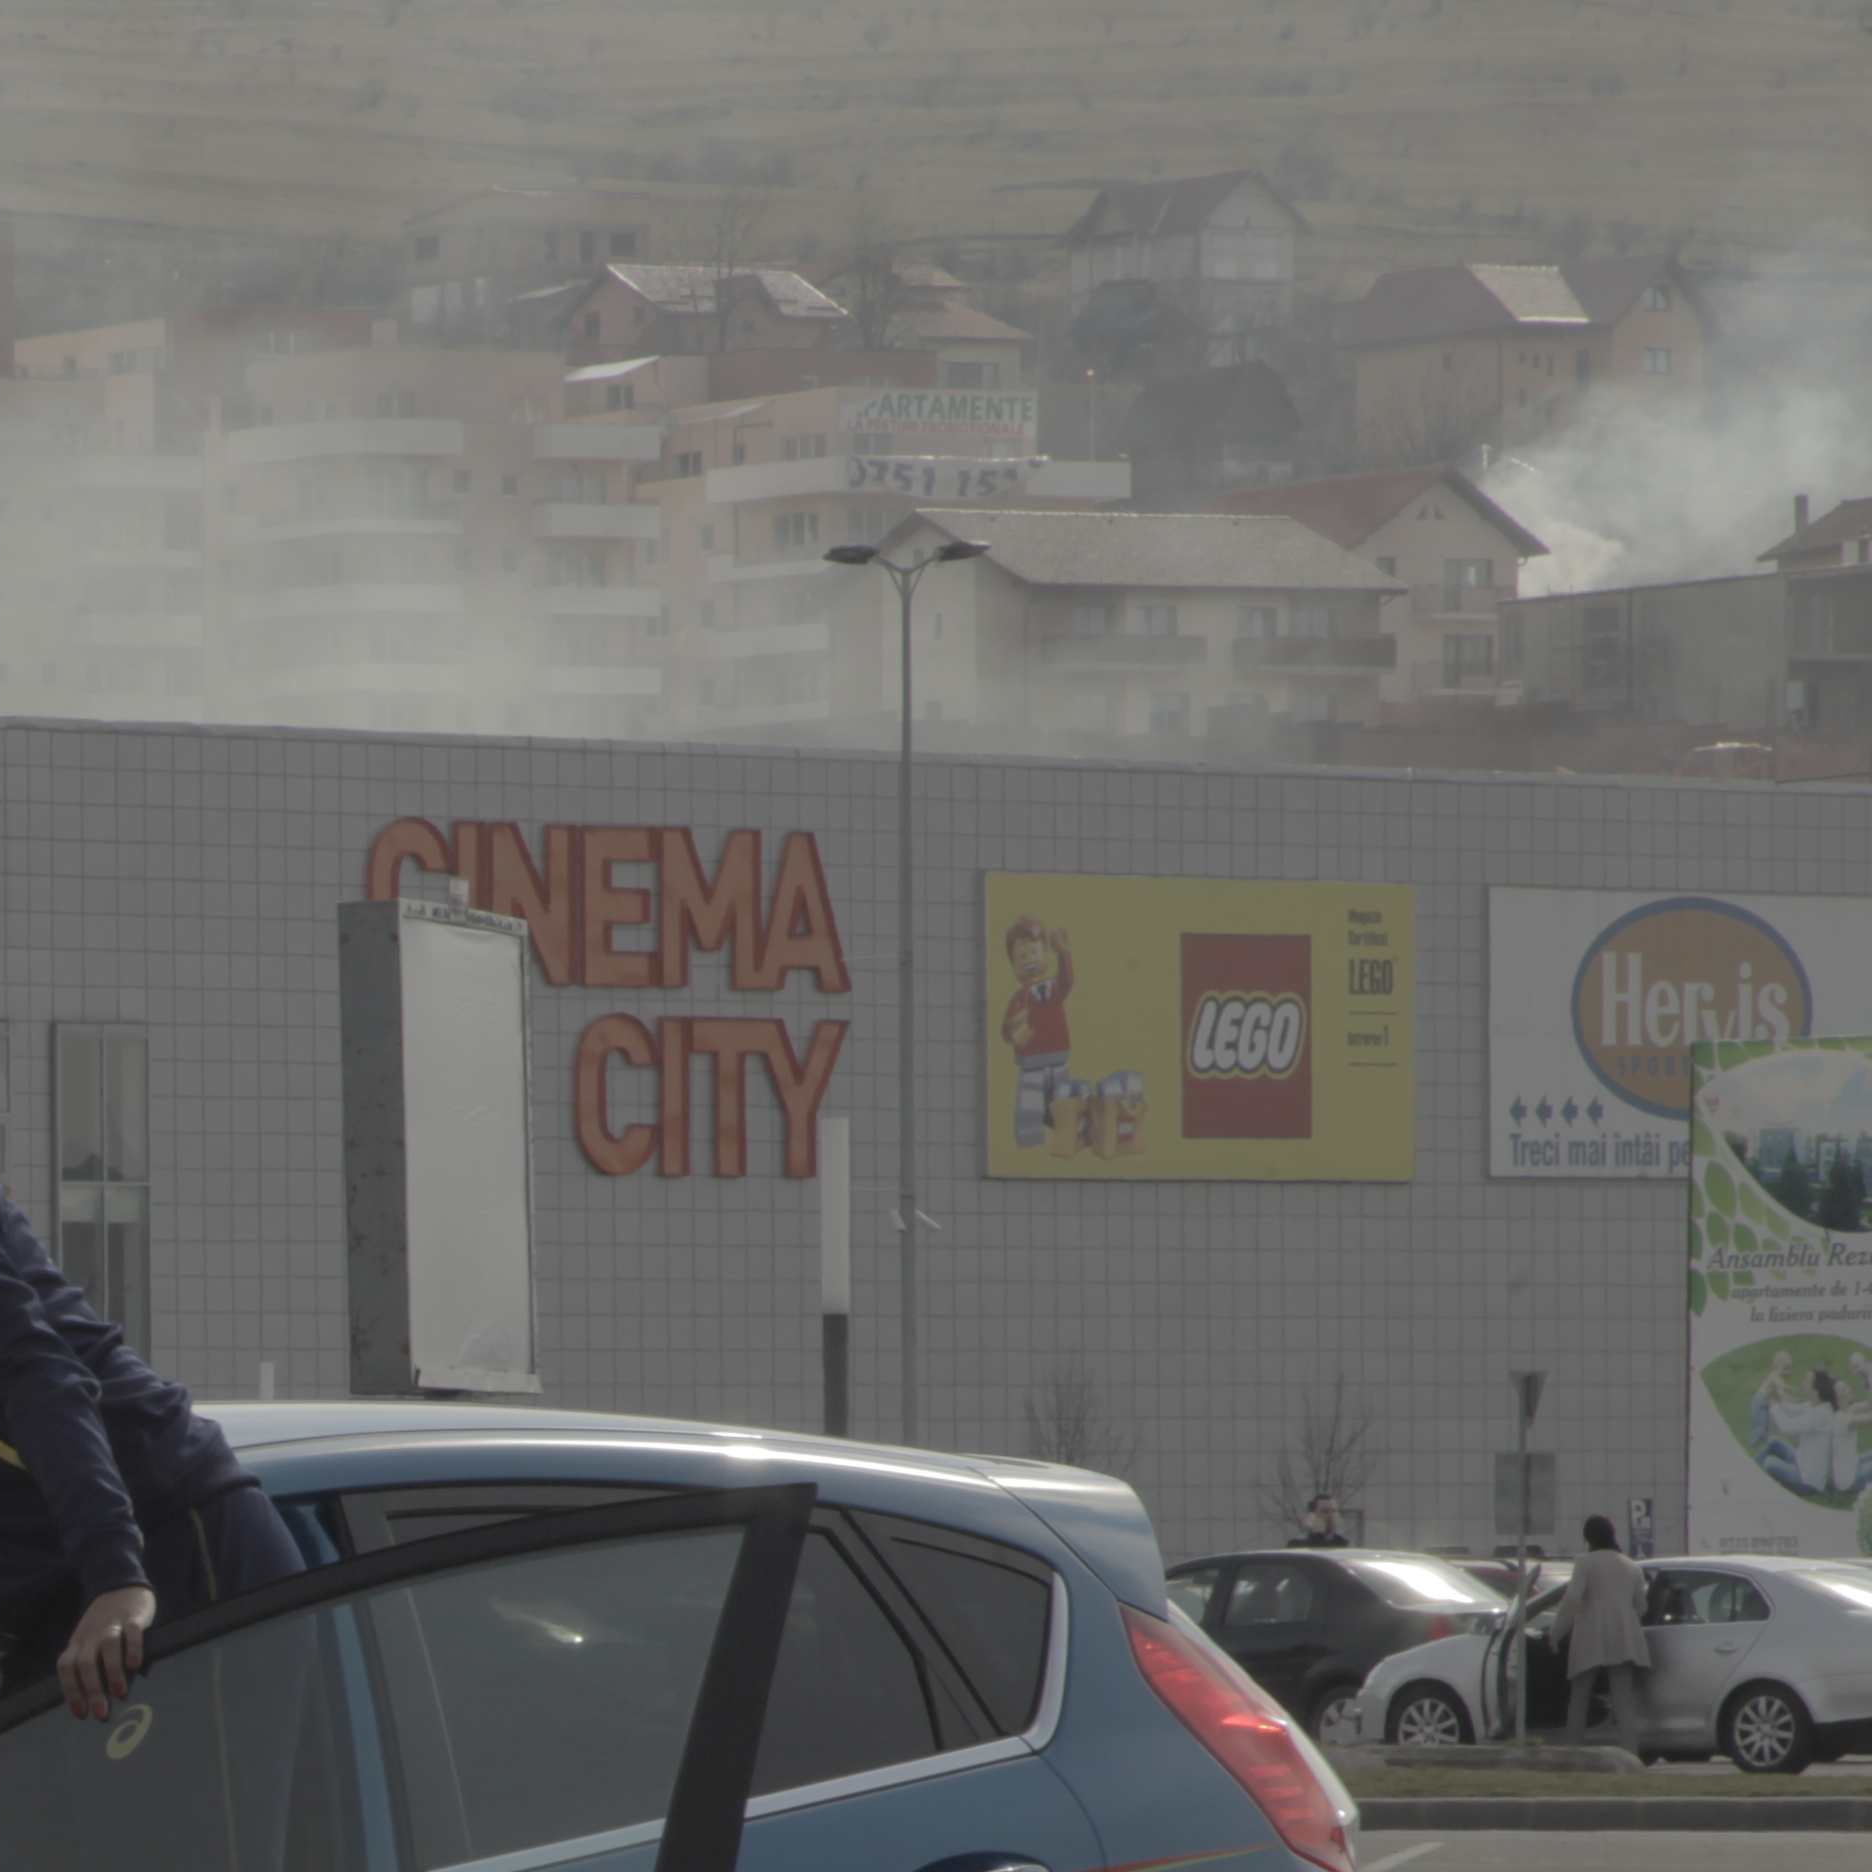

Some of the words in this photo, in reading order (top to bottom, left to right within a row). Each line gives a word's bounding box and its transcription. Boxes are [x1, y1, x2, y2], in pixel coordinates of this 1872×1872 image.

[855, 394, 1033, 422] ARTAMENTE
[847, 419, 864, 431] LA
[1347, 958, 1394, 995] LEGO
[1600, 951, 1791, 1048] Hervis
[1191, 997, 1303, 1073] LEGO
[574, 1012, 851, 1179] CITY
[1509, 1132, 1560, 1166] Treci
[1568, 1133, 1607, 1166] mai
[1614, 1133, 1661, 1166] întâi
[1708, 1243, 1820, 1269] Ansamblu
[1732, 1283, 1826, 1301] apartamente
[1830, 1280, 1848, 1296] de
[1750, 1306, 1764, 1322] la
[1769, 1306, 1814, 1322] liziera
